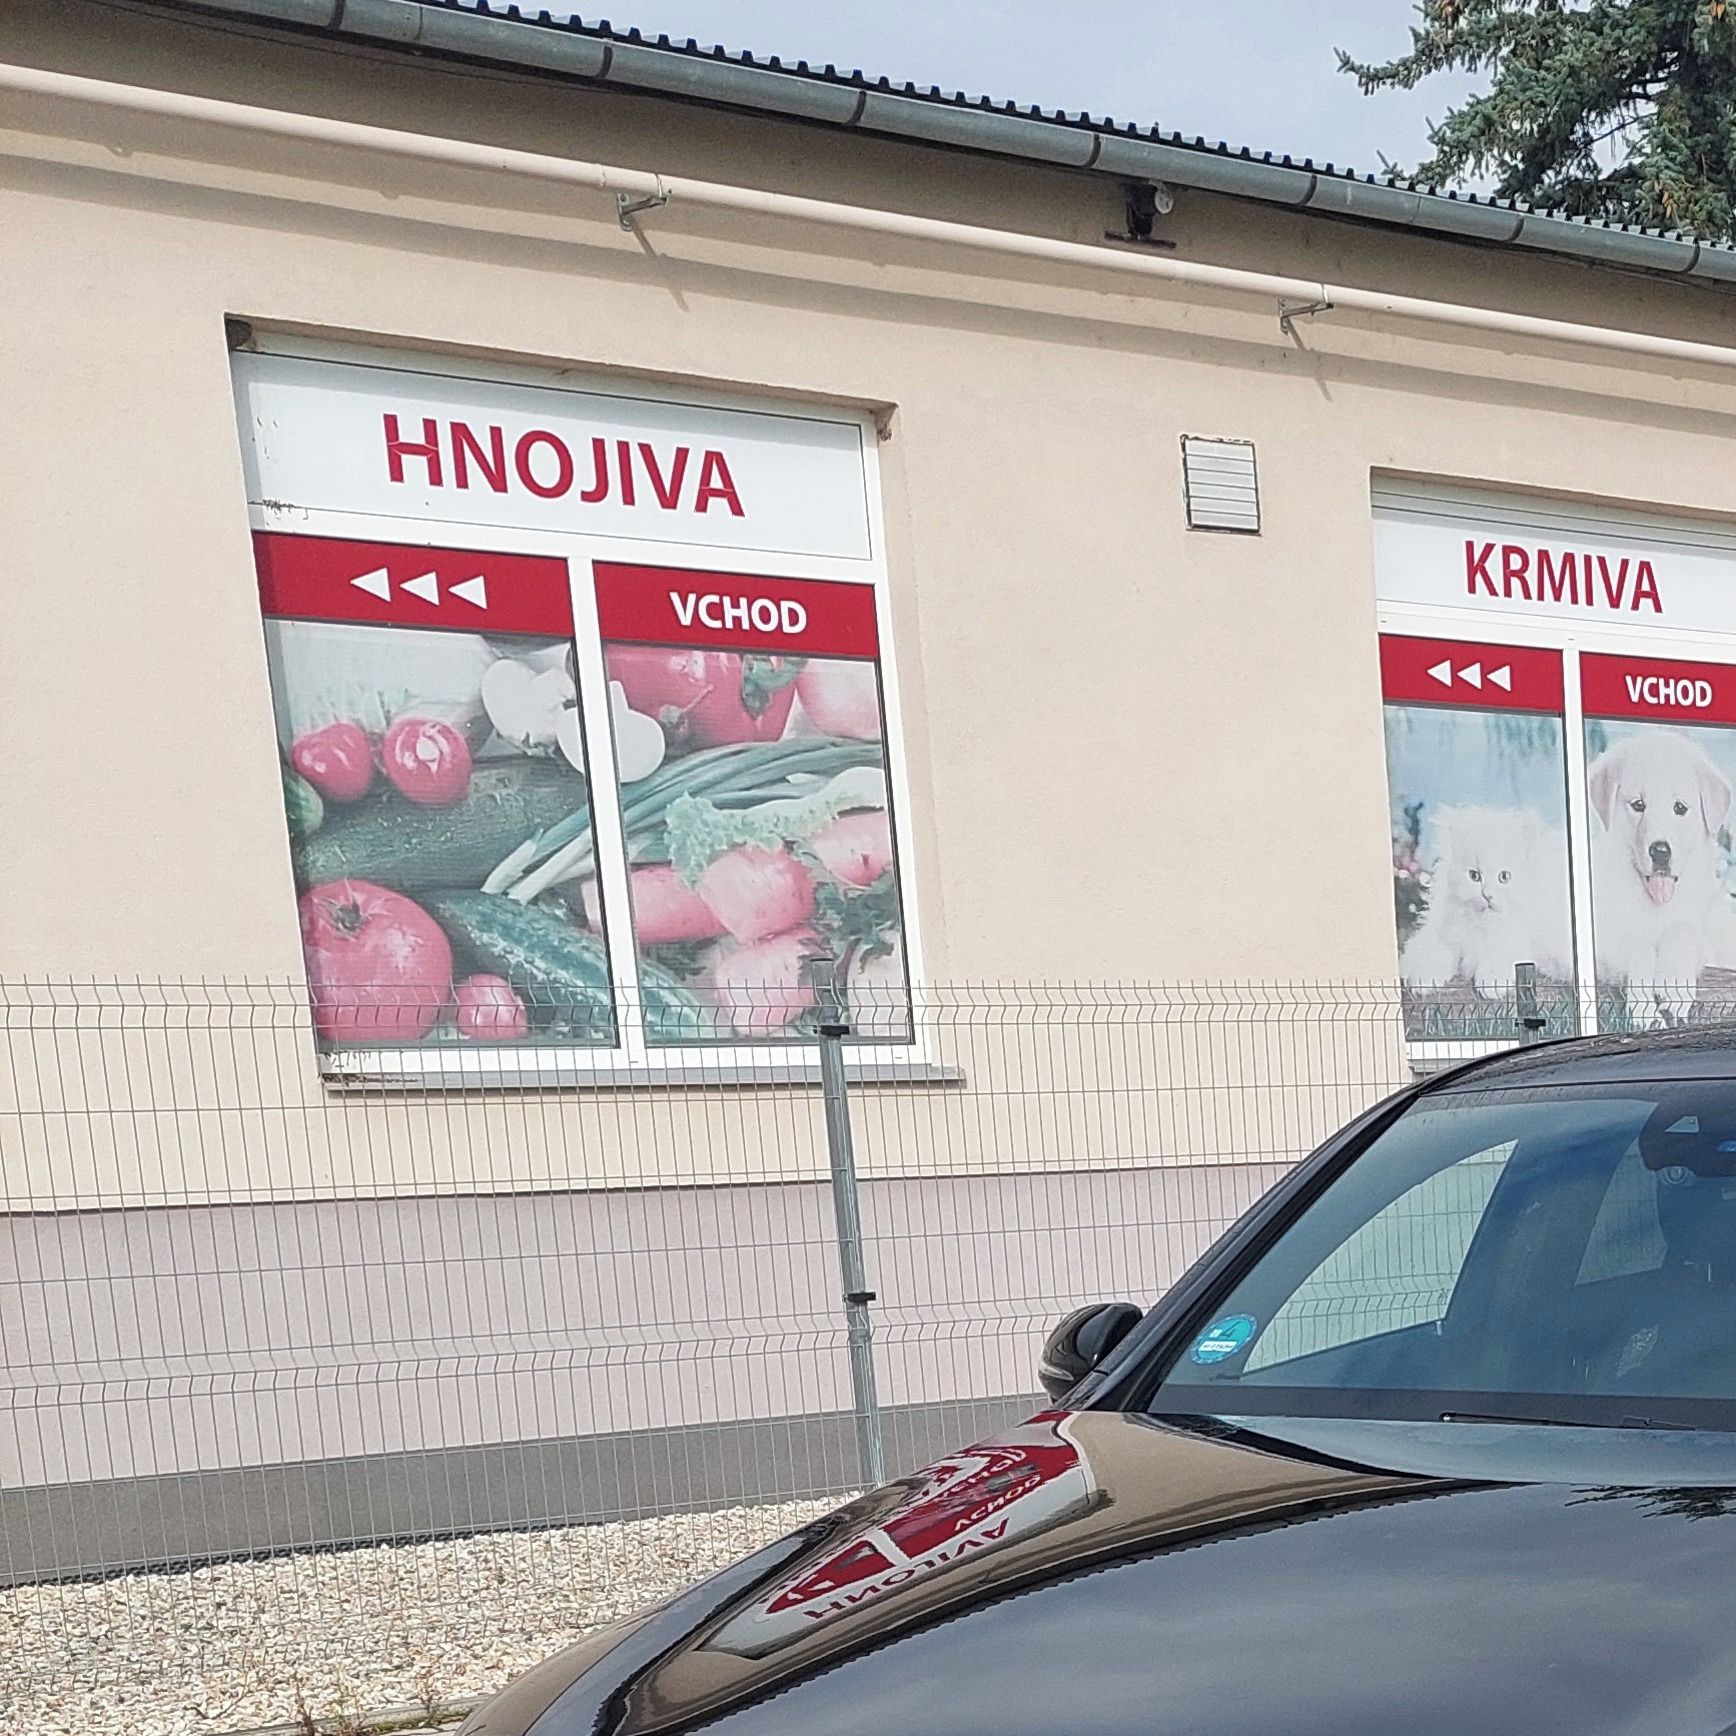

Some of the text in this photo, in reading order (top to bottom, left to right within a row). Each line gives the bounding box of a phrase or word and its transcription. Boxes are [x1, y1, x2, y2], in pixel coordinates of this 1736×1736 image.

[383, 413, 745, 517] HNOJIVA
[1465, 540, 1663, 613] KRMIVA
[669, 592, 806, 634] VCHOD
[1625, 675, 1713, 707] VCHOD
